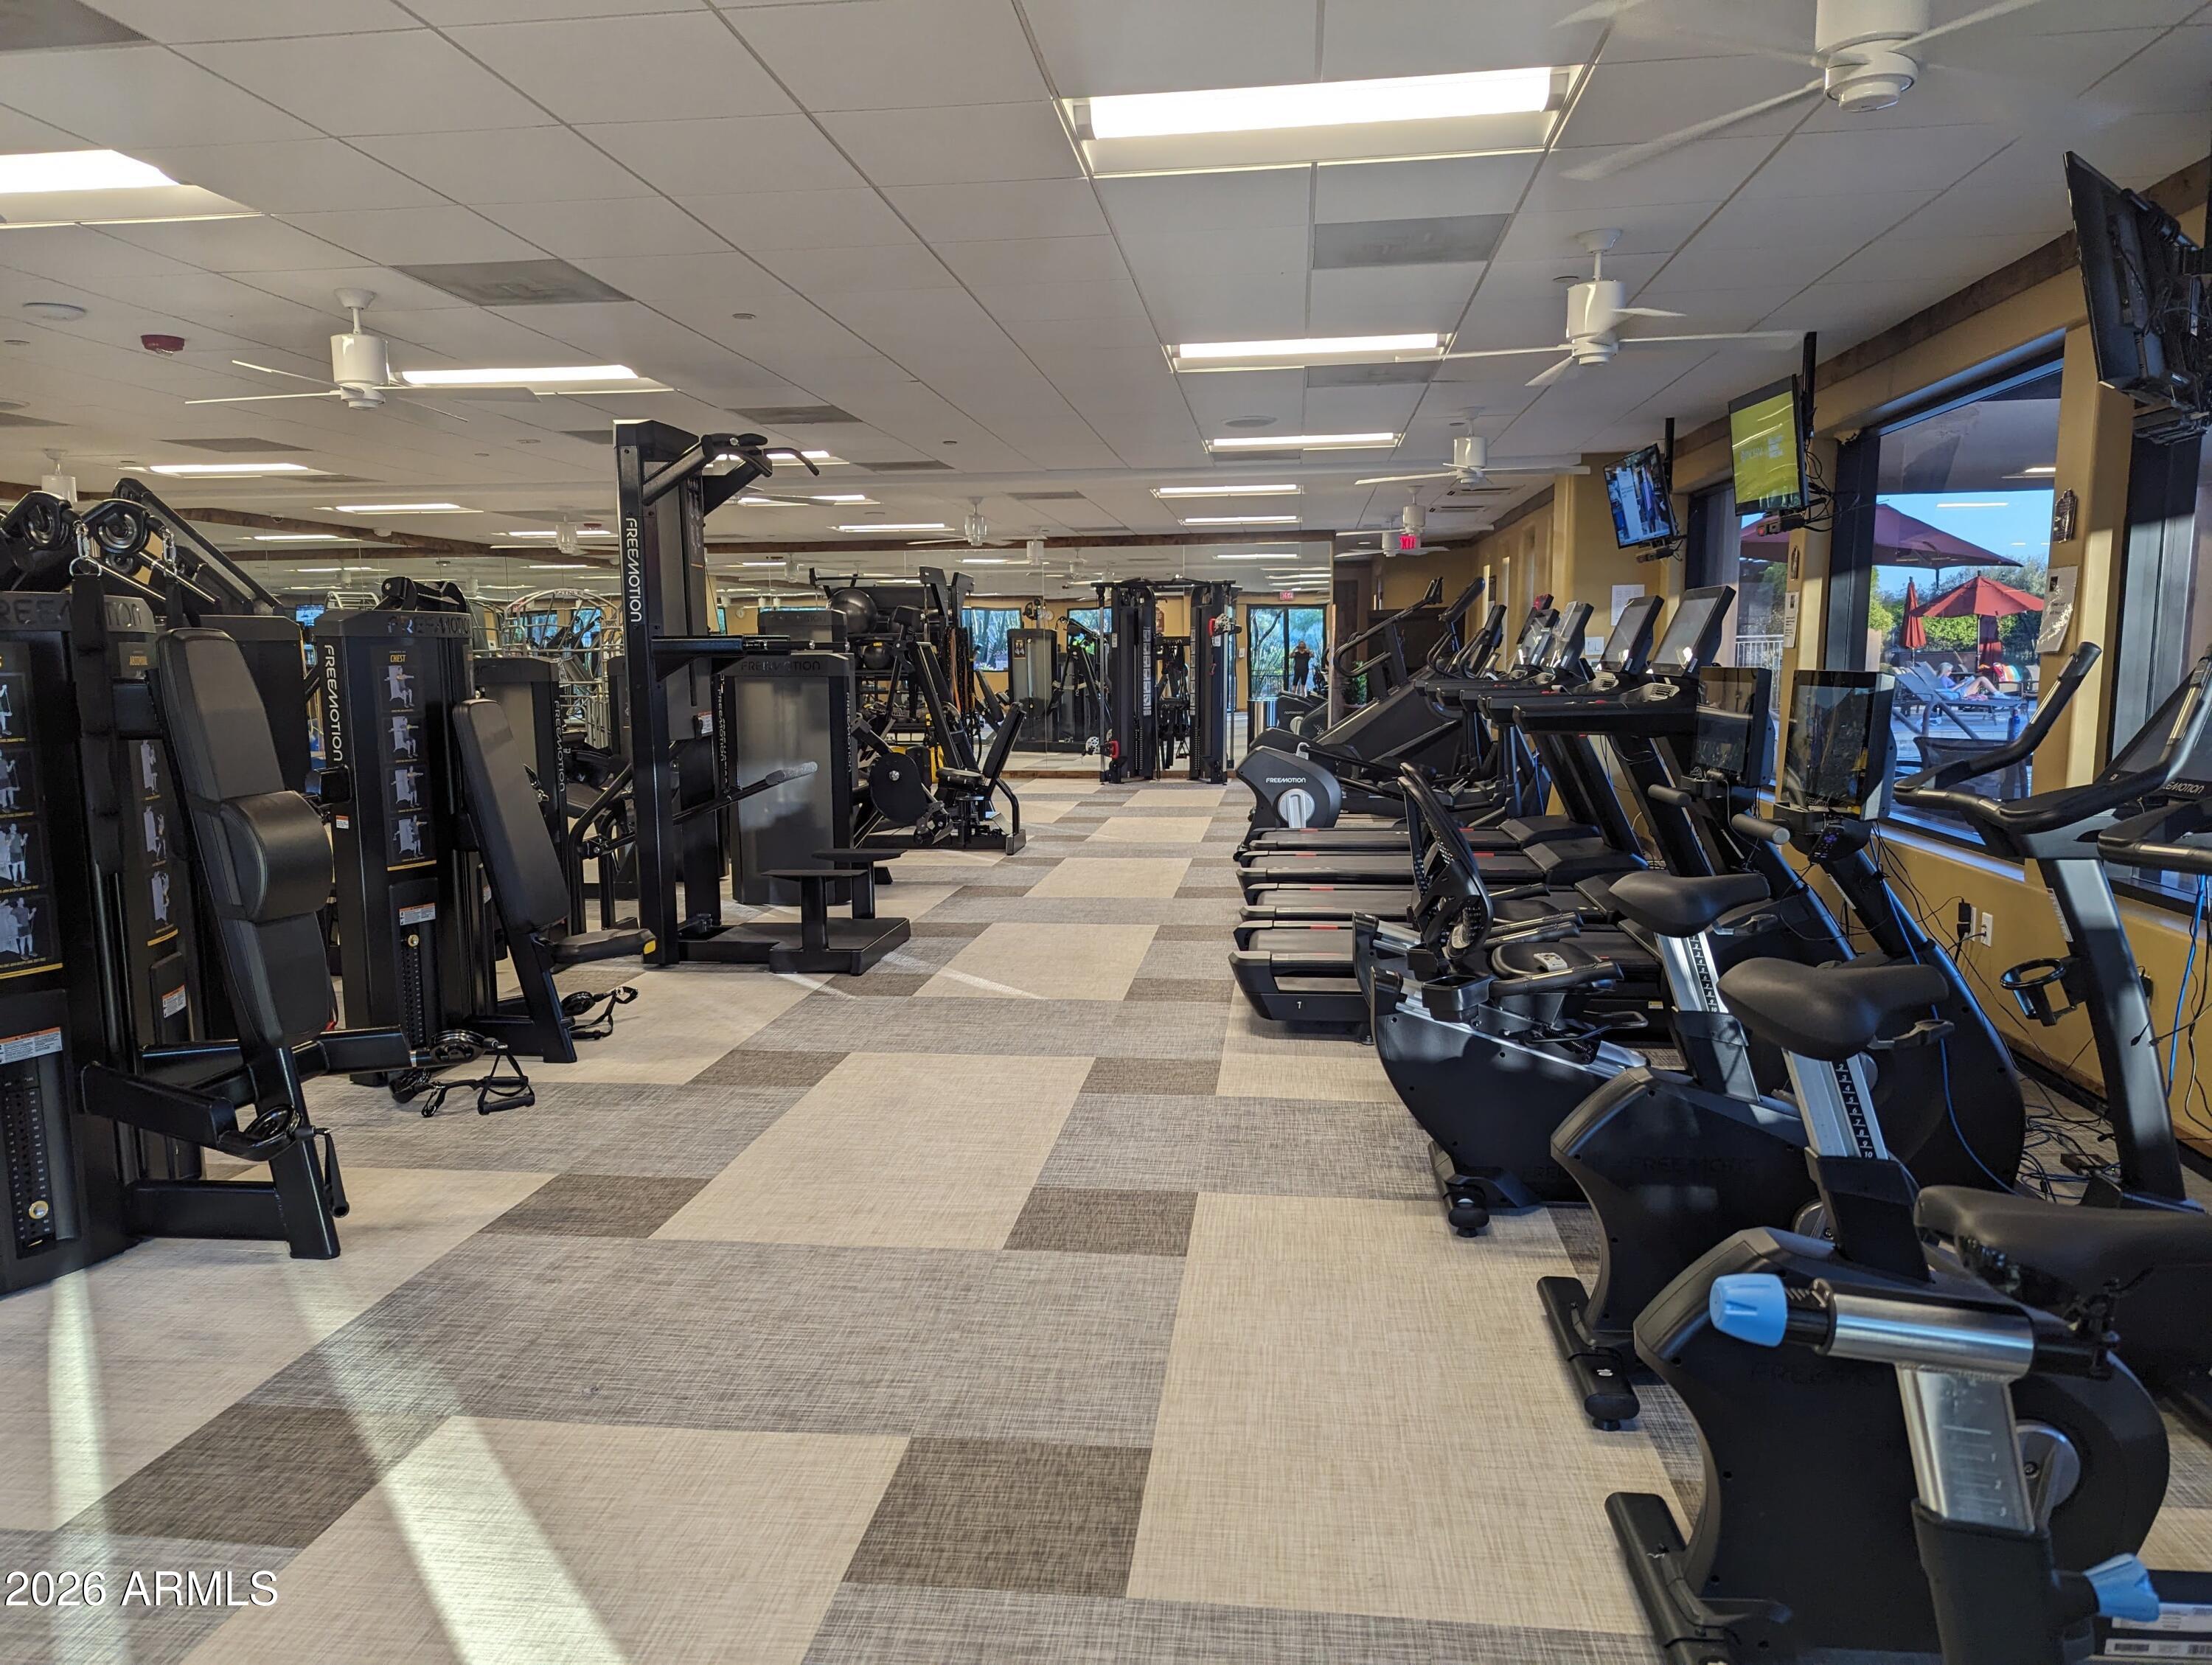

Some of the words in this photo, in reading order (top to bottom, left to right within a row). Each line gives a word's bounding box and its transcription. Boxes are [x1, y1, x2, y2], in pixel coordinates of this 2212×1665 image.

[625, 517, 642, 622] FREEMOTION
[389, 654, 406, 662] CHEST
[324, 644, 343, 762] FREEMOTION
[554, 700, 566, 793] FREEMOTION
[2163, 782, 2205, 794] EMOTION
[1297, 1001, 1302, 1009] 7
